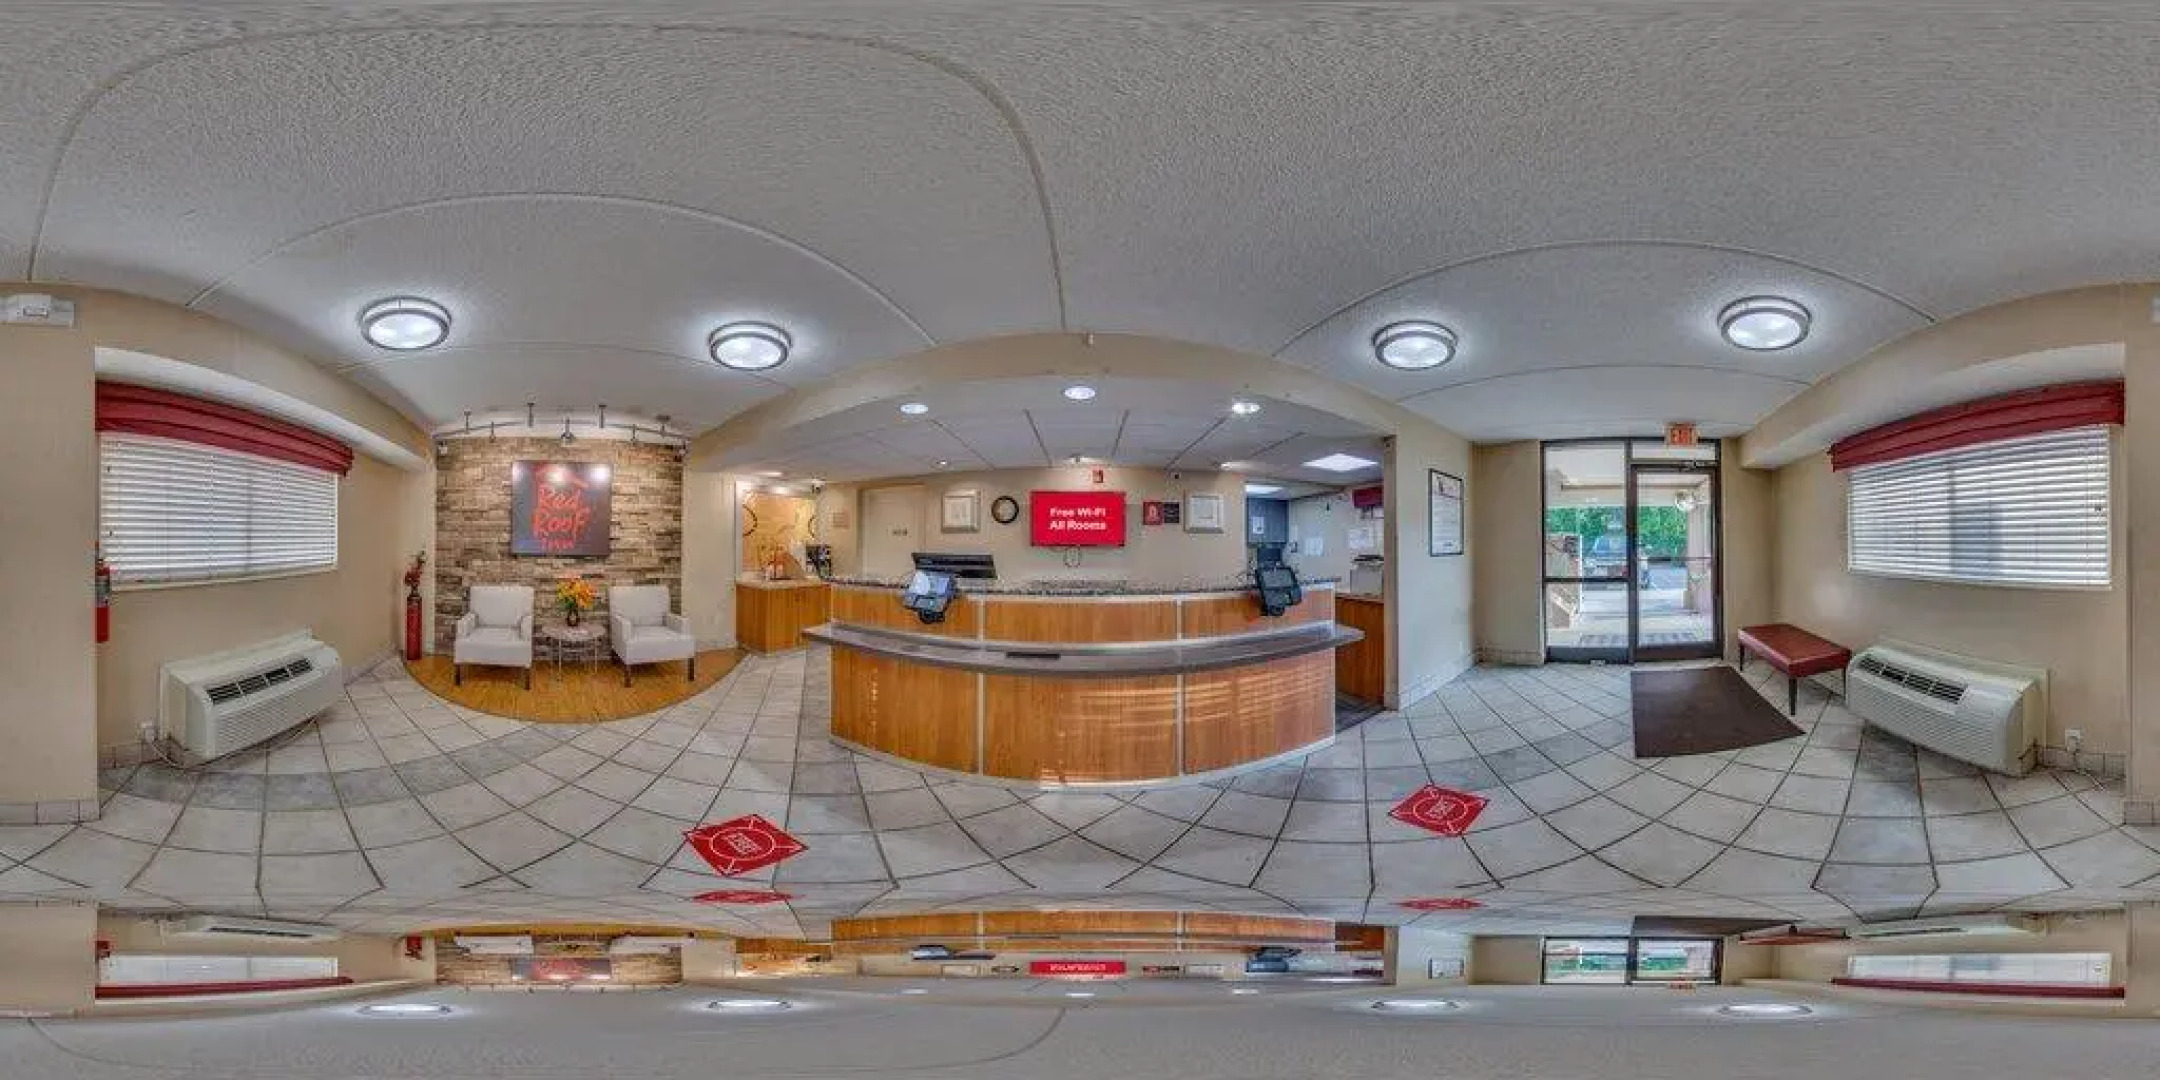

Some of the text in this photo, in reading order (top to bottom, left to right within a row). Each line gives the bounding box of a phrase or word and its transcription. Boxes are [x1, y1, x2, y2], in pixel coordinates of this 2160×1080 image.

[1671, 427, 1693, 445] EXIT
[538, 486, 581, 509] Red
[1049, 507, 1106, 517] Free Wi-Fi
[531, 506, 593, 540] Roof
[1049, 520, 1107, 530] All Rooms
